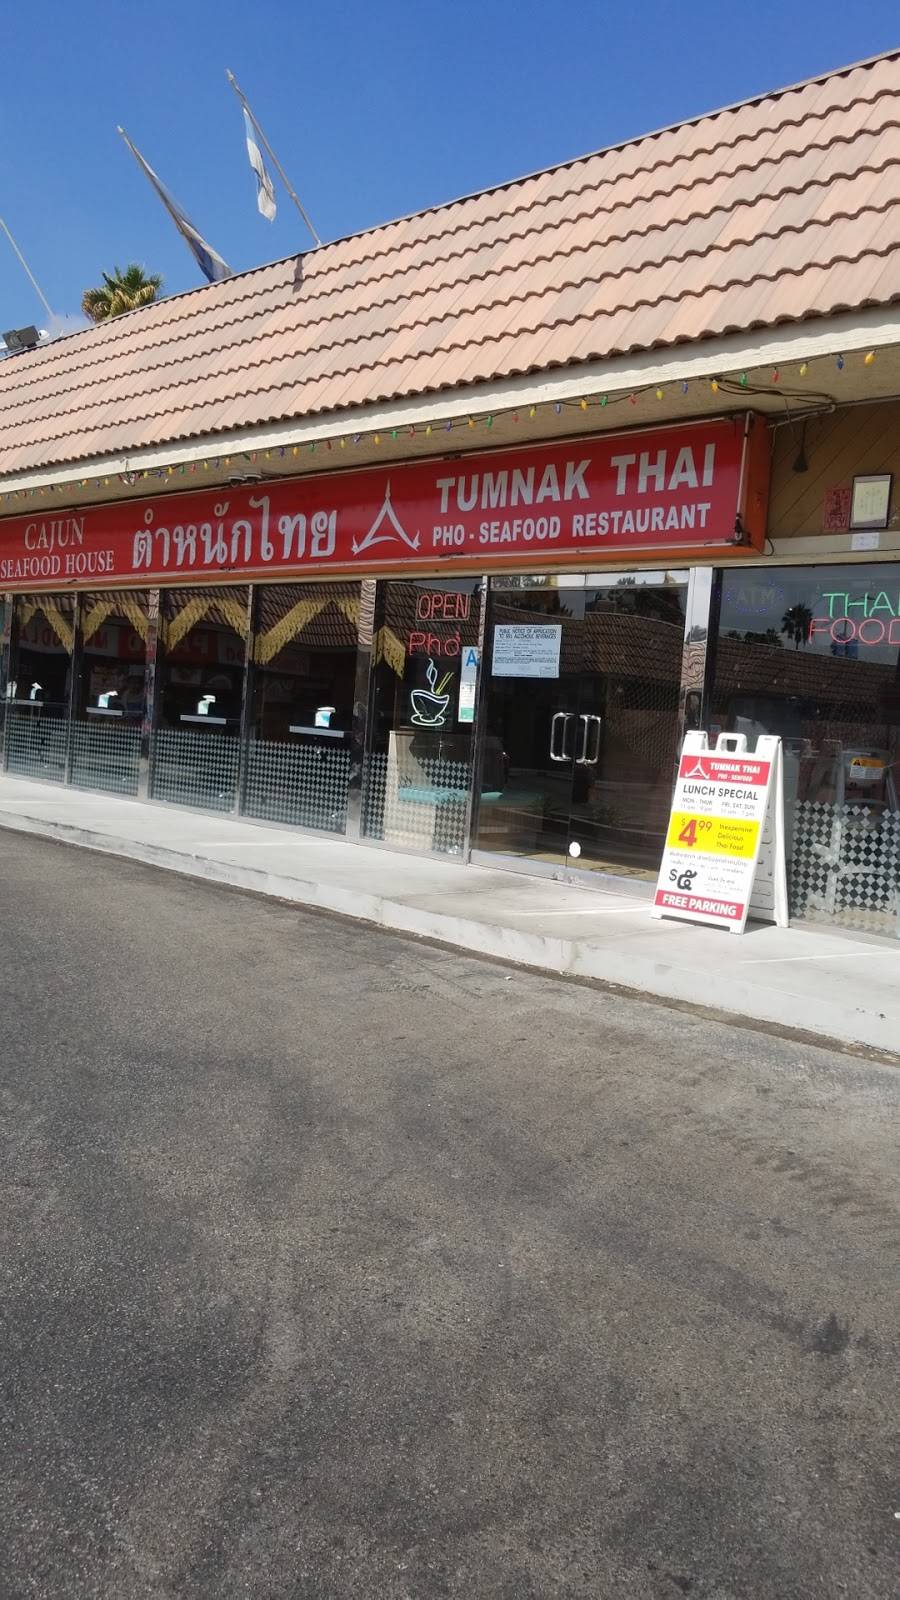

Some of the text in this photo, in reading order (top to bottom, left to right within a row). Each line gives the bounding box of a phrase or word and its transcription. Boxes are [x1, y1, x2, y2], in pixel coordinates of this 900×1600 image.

[436, 443, 716, 514] TUMNAK THAI
[24, 517, 86, 553] CAJUN
[132, 496, 338, 568] ตำหนักไทย
[432, 524, 465, 547] PHO
[479, 516, 561, 544] SEAFOOD
[572, 503, 711, 537] RESTAURANT
[0, 550, 115, 579] SEAFOOD HOUSE
[418, 593, 469, 619] OPEN
[466, 649, 477, 667] A
[710, 762, 761, 774] TUMNAK THAI
[683, 784, 759, 801] LUNCH SPECIAL
[717, 832, 744, 842] Delicious
[720, 823, 753, 833] Inexpensive
[662, 893, 737, 917] FREE PARKING
